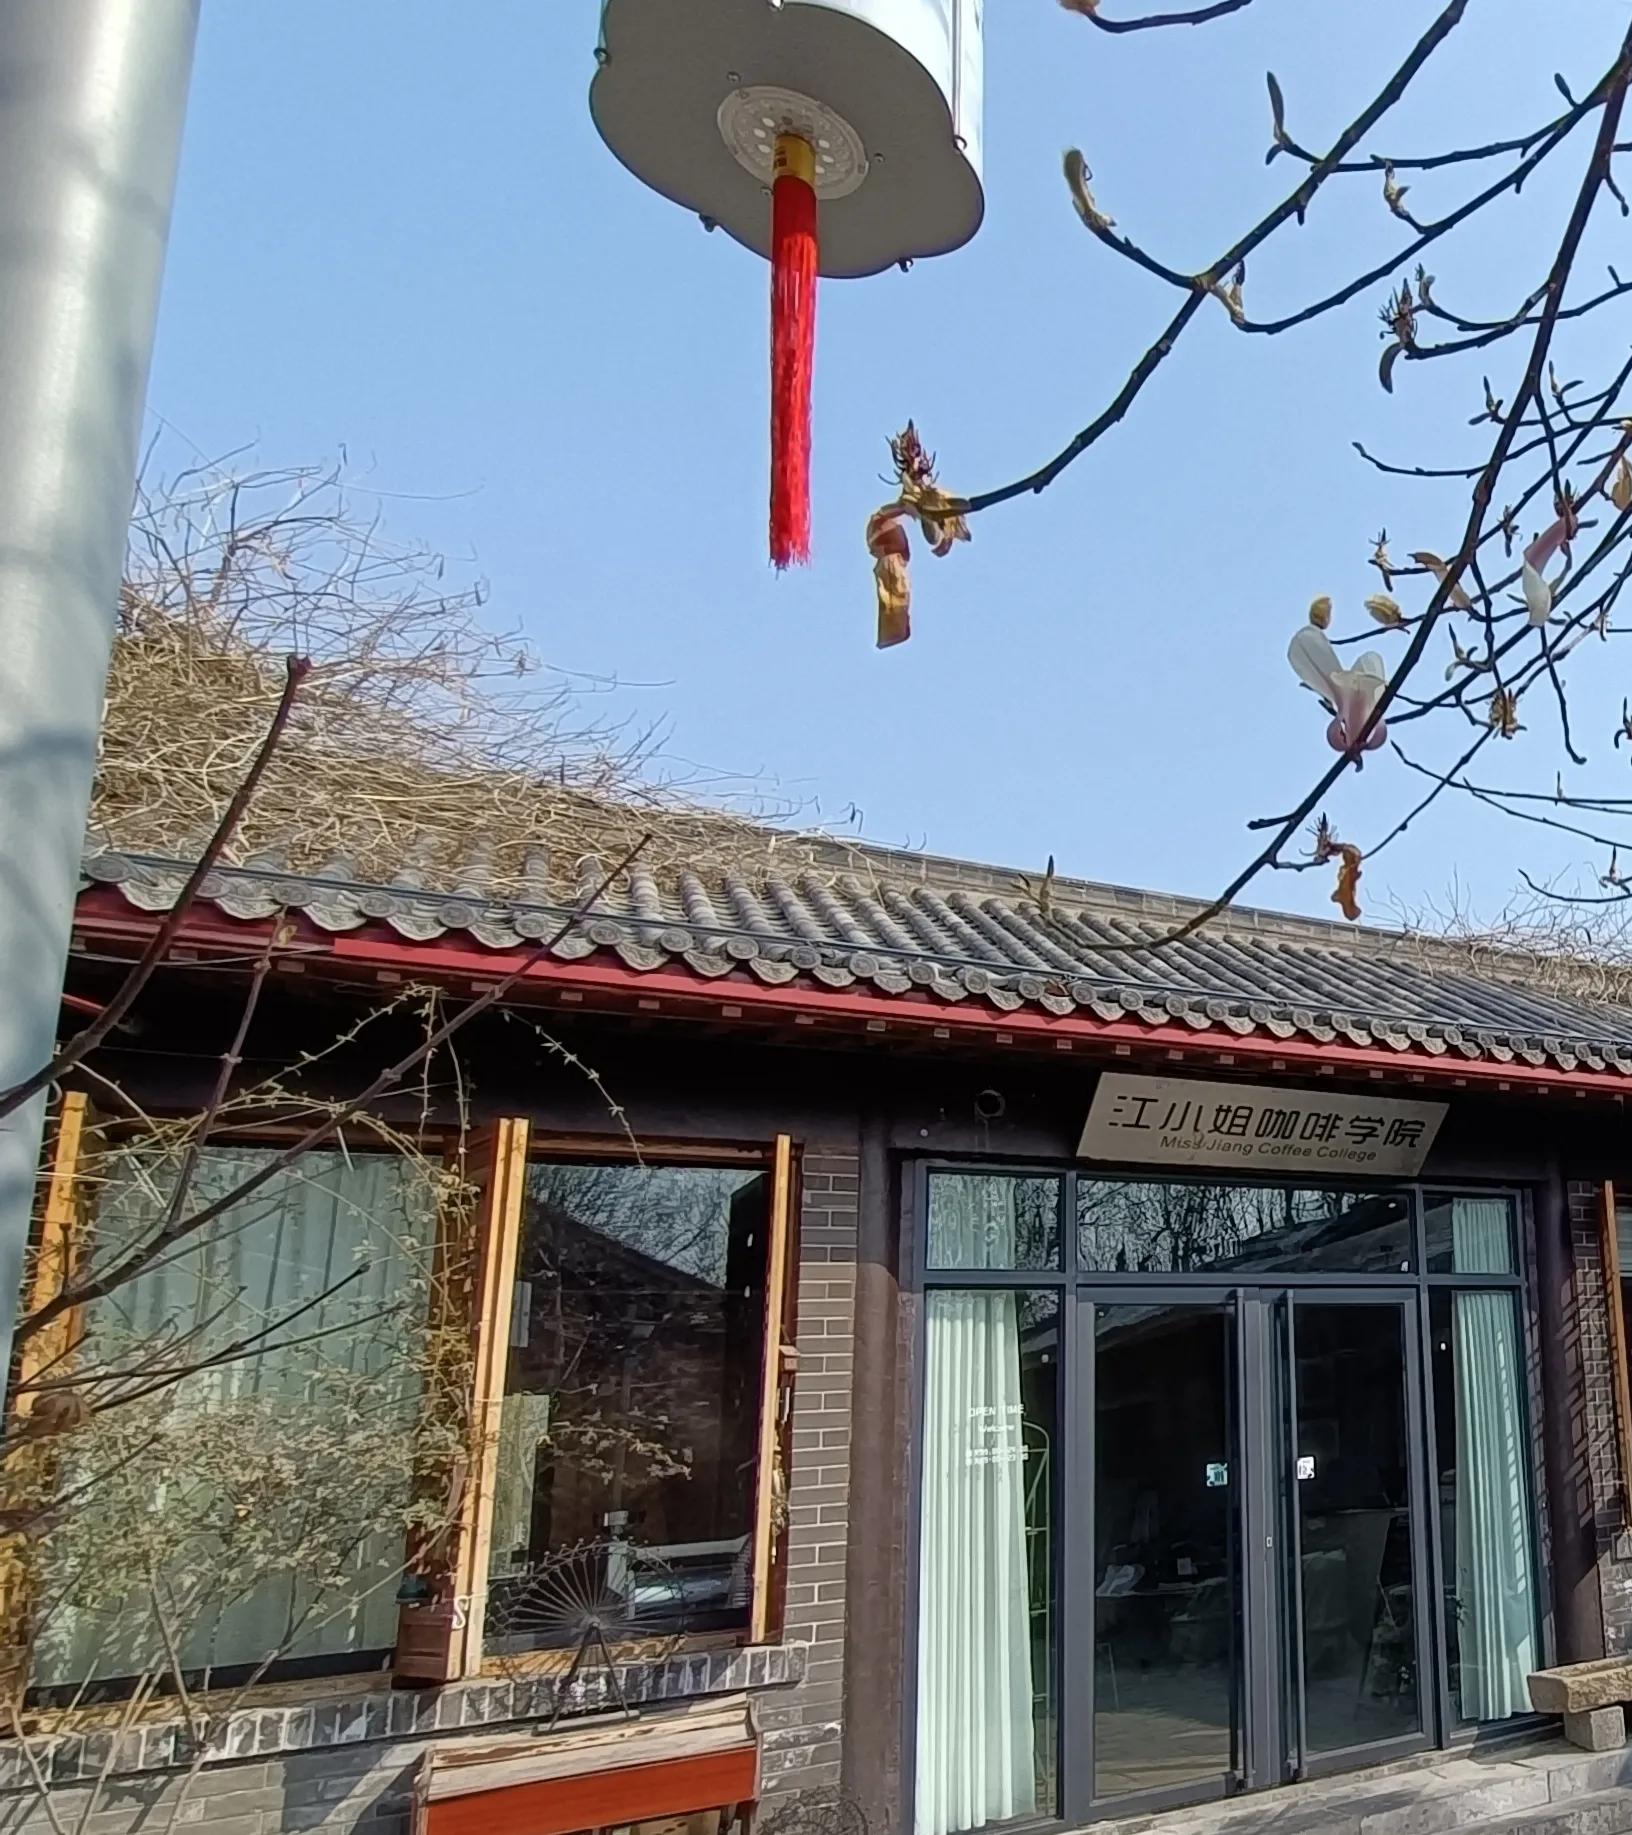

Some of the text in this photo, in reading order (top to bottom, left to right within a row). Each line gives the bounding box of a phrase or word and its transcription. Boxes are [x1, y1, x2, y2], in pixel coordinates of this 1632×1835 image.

[1108, 1095, 1426, 1149] 江小姐咖啡学院
[1206, 1139, 1253, 1156] Jiang
[1258, 1142, 1311, 1157] Coffee
[1316, 1146, 1377, 1163] College
[967, 1406, 996, 1419] OPEN
